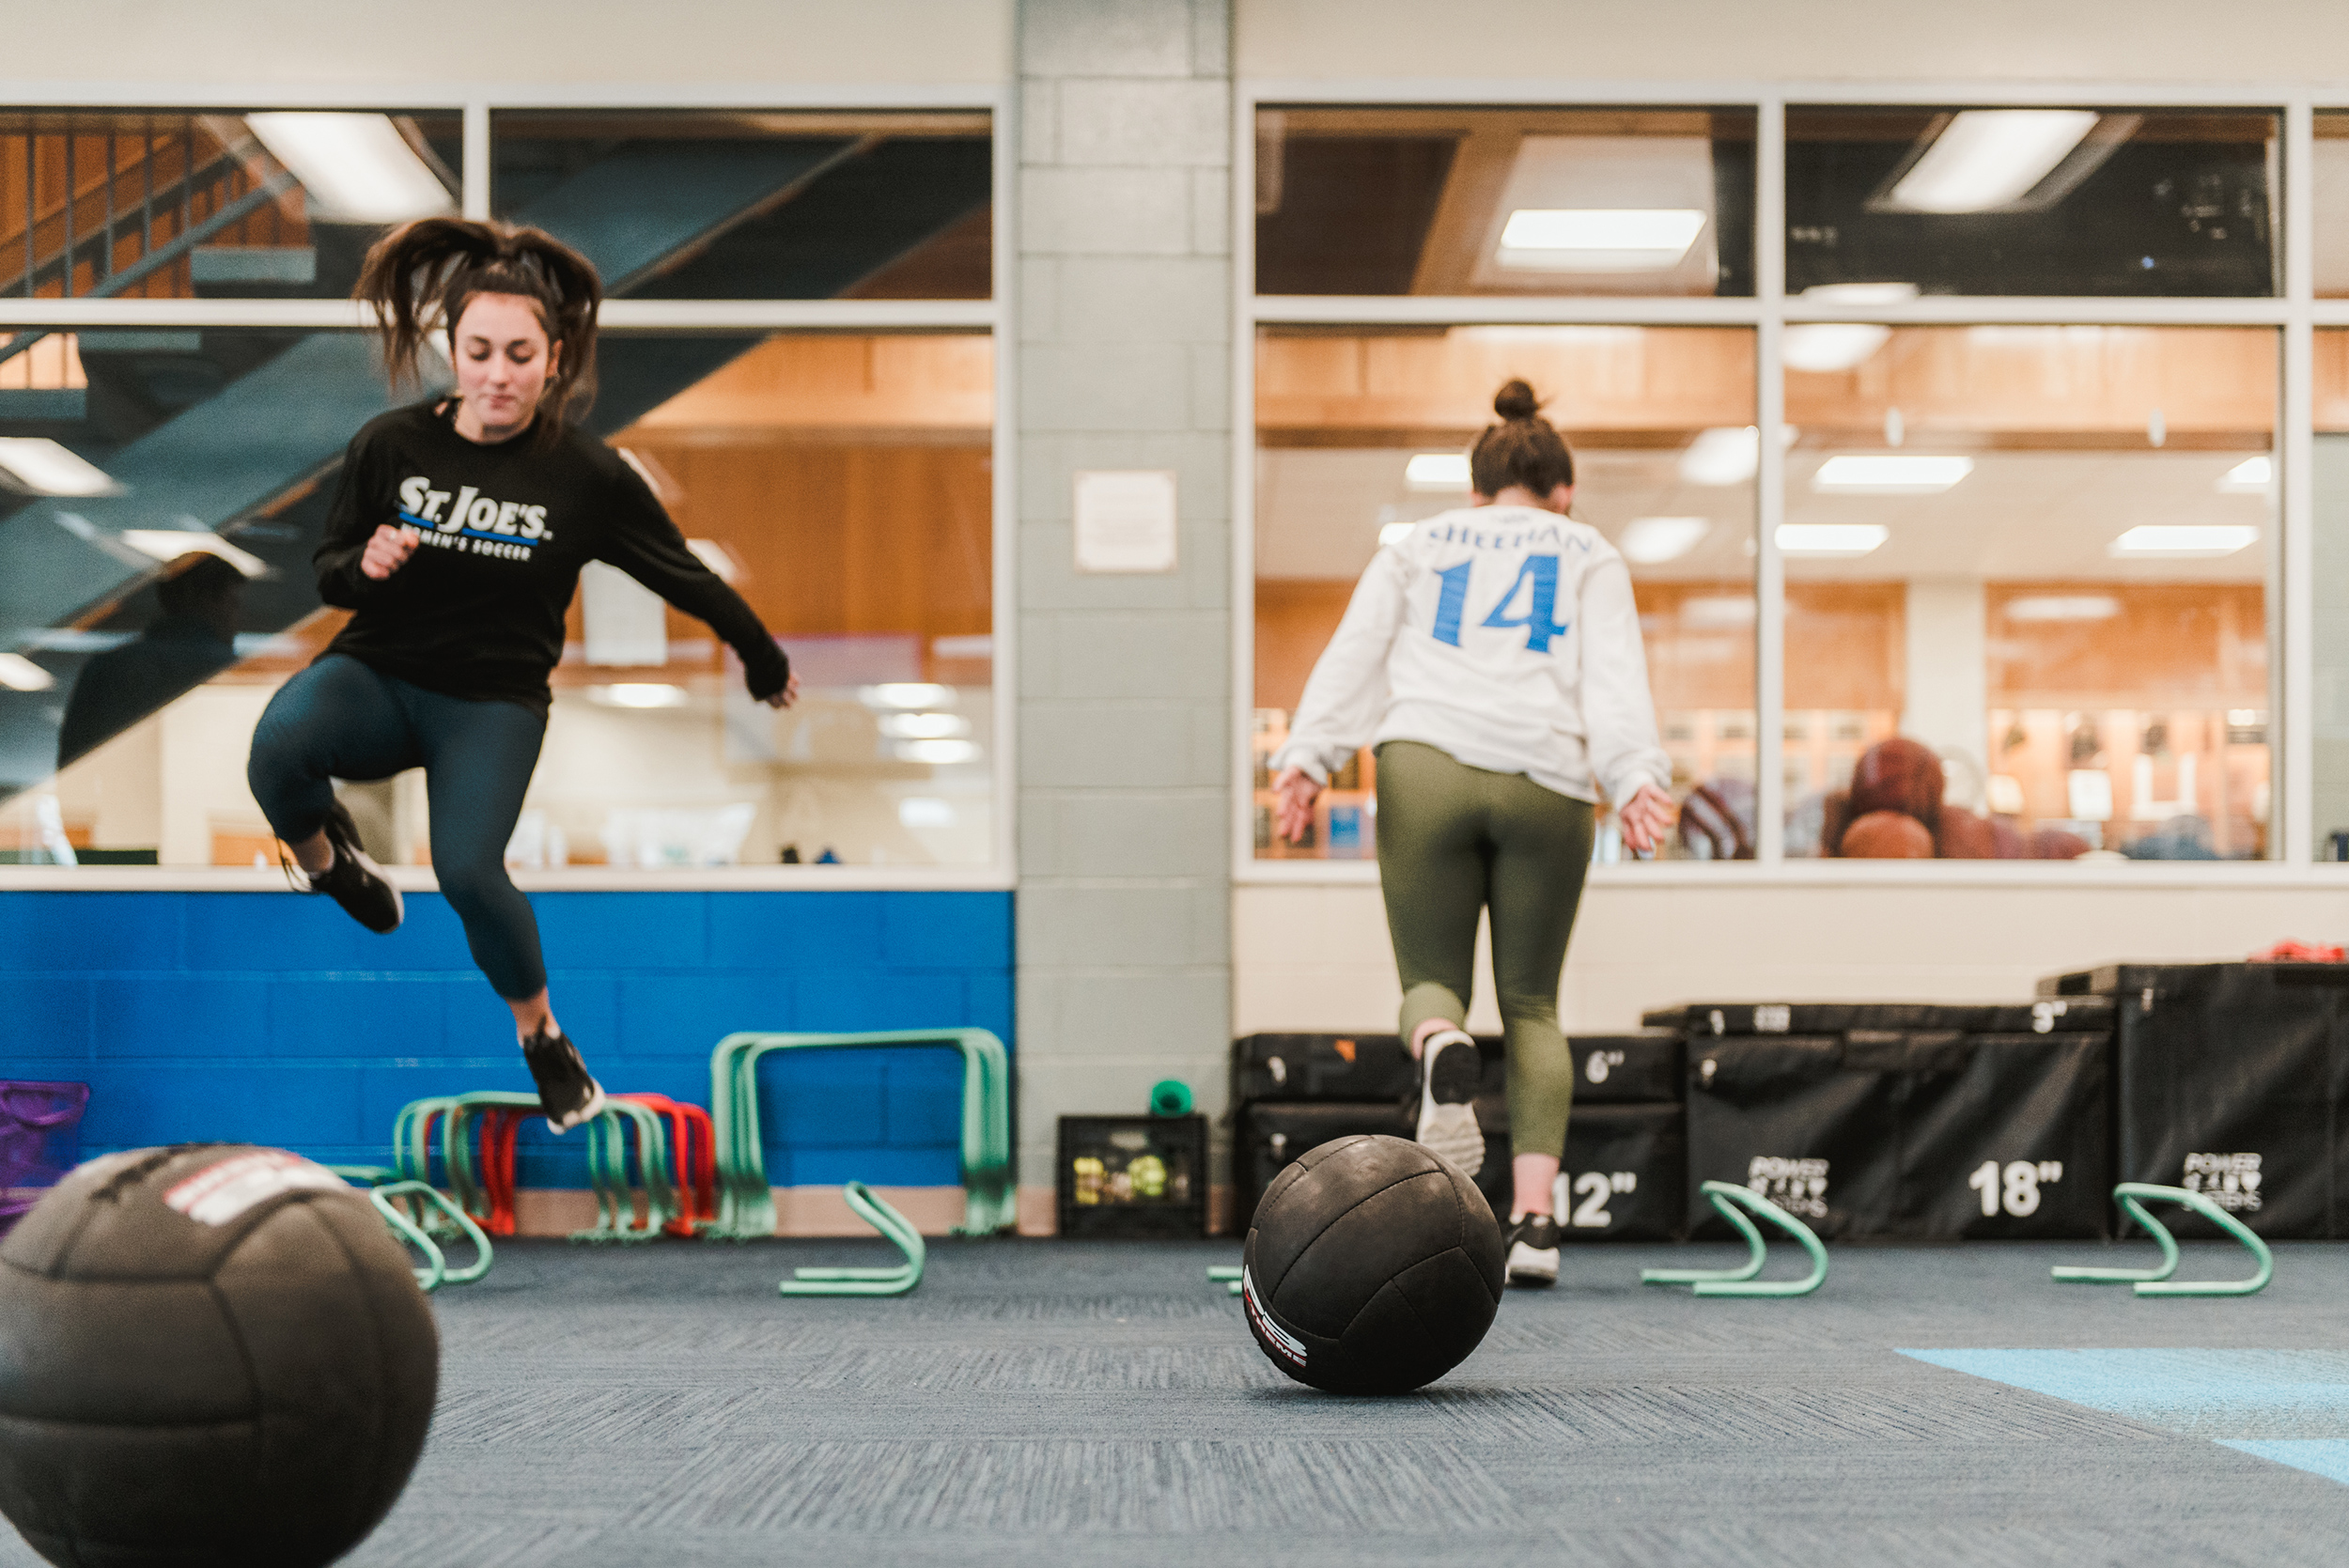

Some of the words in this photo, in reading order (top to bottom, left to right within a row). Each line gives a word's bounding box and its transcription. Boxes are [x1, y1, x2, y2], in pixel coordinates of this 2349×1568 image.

[437, 485, 547, 539] JOE'S
[1431, 553, 1570, 654] 14
[1553, 1172, 1637, 1227] 12"
[1968, 1160, 2063, 1217] 18"
